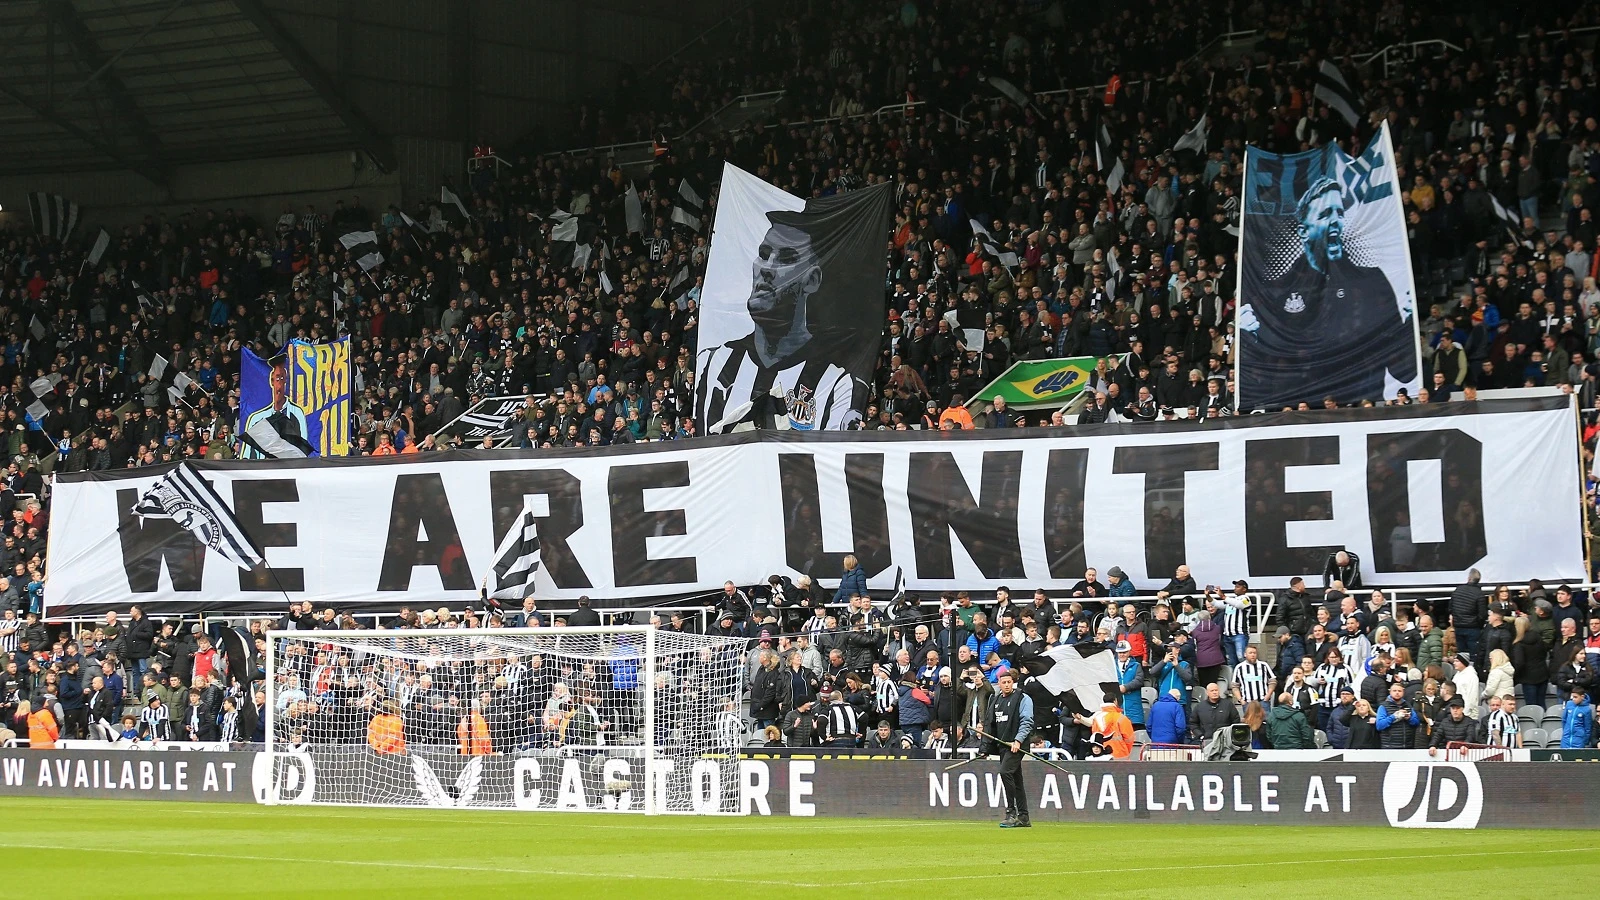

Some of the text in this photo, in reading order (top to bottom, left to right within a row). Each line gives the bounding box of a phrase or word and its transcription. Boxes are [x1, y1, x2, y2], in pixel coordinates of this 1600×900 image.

[288, 340, 349, 416] ISAK
[319, 399, 349, 457] 14
[116, 428, 1487, 592] WE ARE UNITED
[37, 759, 189, 791] AVAILABLE
[203, 762, 236, 792] AT
[513, 758, 816, 816] CASTORE
[1040, 774, 1280, 812] AVAILABLE
[1304, 775, 1356, 812] AT
[1397, 766, 1468, 822] JD
